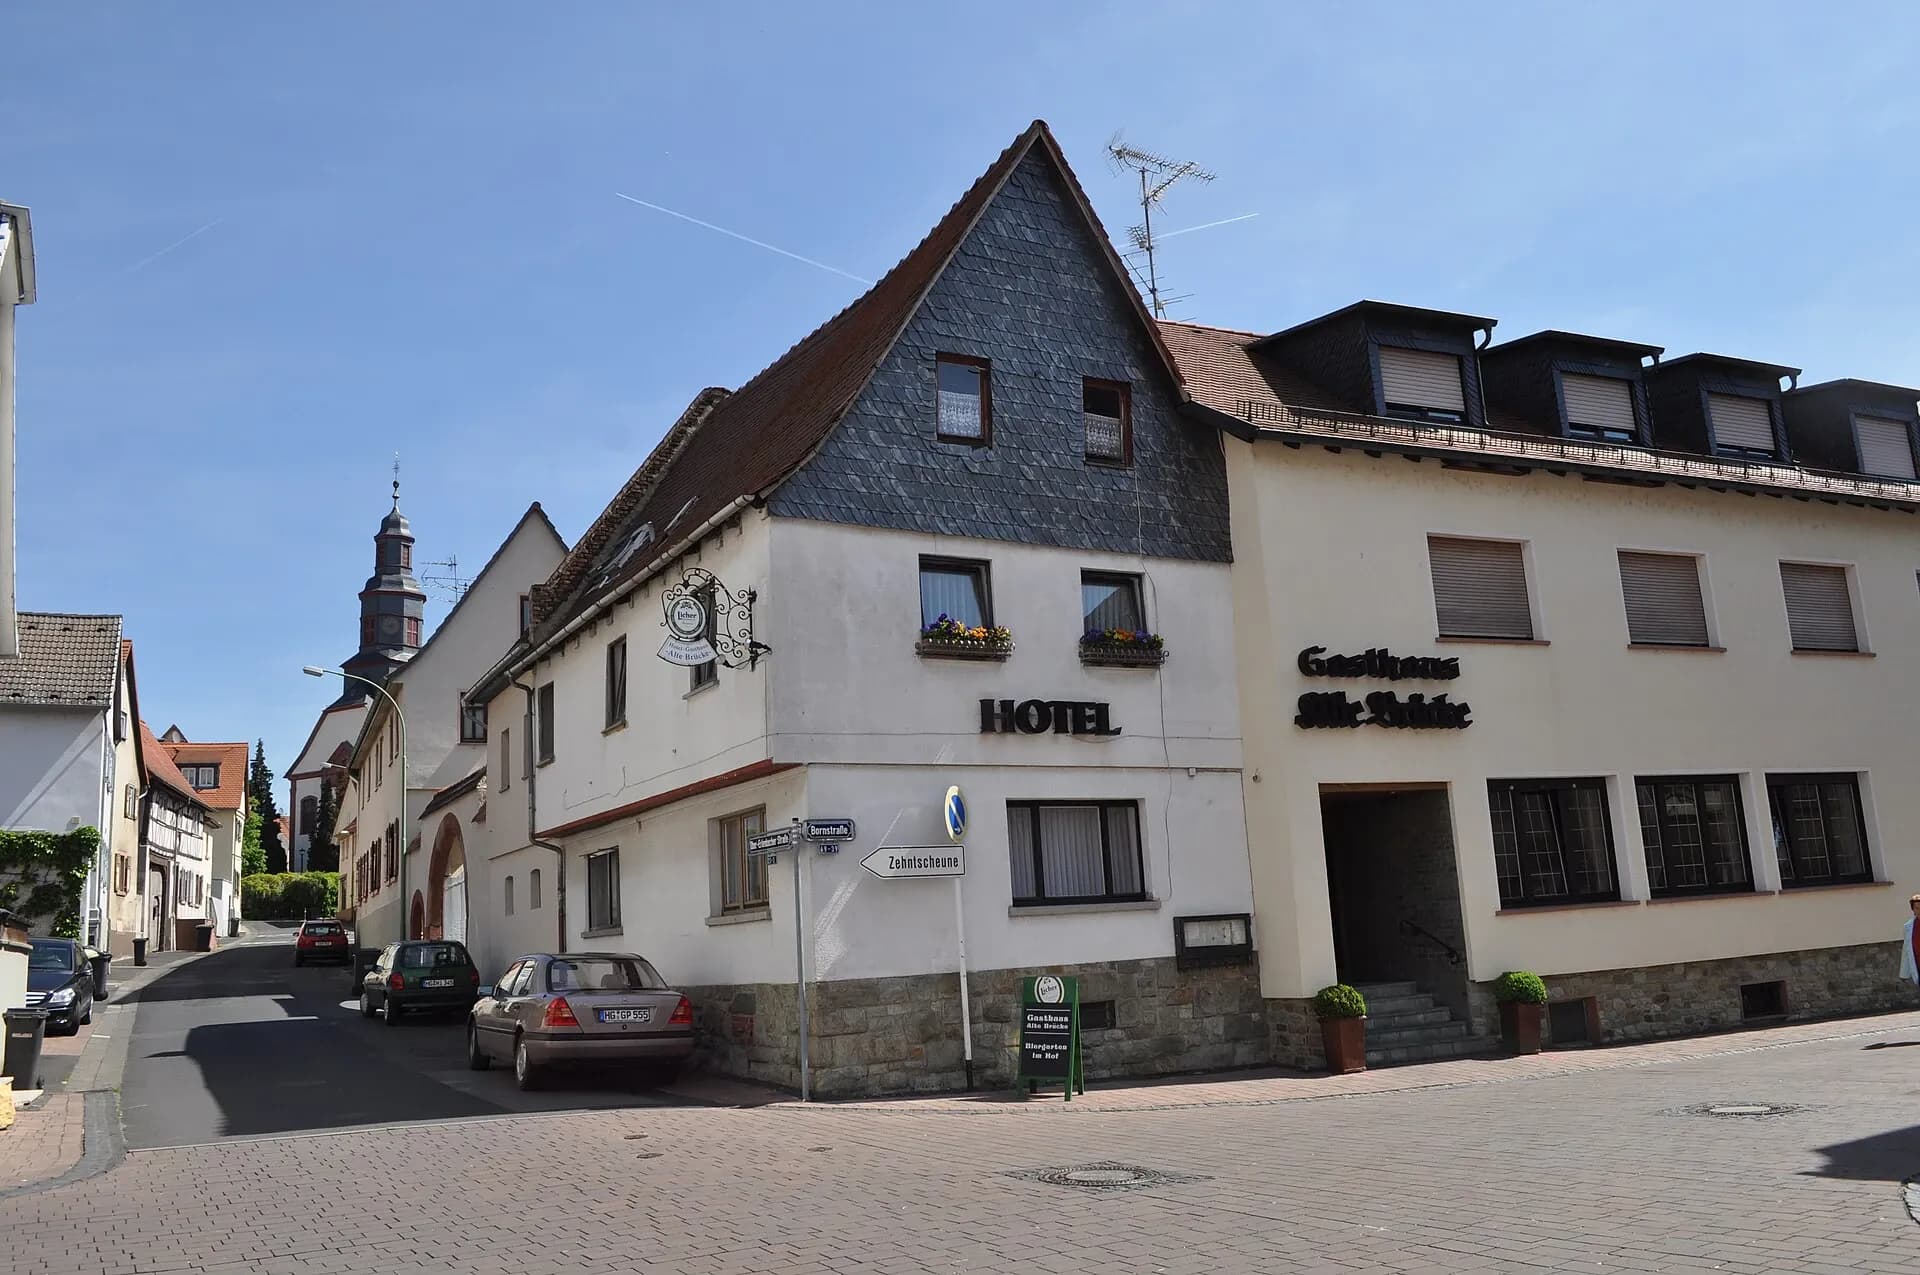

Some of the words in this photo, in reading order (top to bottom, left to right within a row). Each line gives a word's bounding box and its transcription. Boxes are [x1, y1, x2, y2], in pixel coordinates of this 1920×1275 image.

[678, 611, 697, 620] Licher
[1298, 645, 1460, 681] Gasthaus
[1294, 691, 1365, 729] Alte
[1365, 691, 1473, 729] Brücke
[979, 699, 1122, 736] HOTEL
[810, 825, 848, 835] Bornstraße
[889, 855, 959, 869] Zehntscheune
[633, 1010, 648, 1019] 555
[1027, 1014, 1069, 1022] Gasthaus
[1025, 1042, 1068, 1051] Biergarten
[1045, 1052, 1059, 1060] Hof
